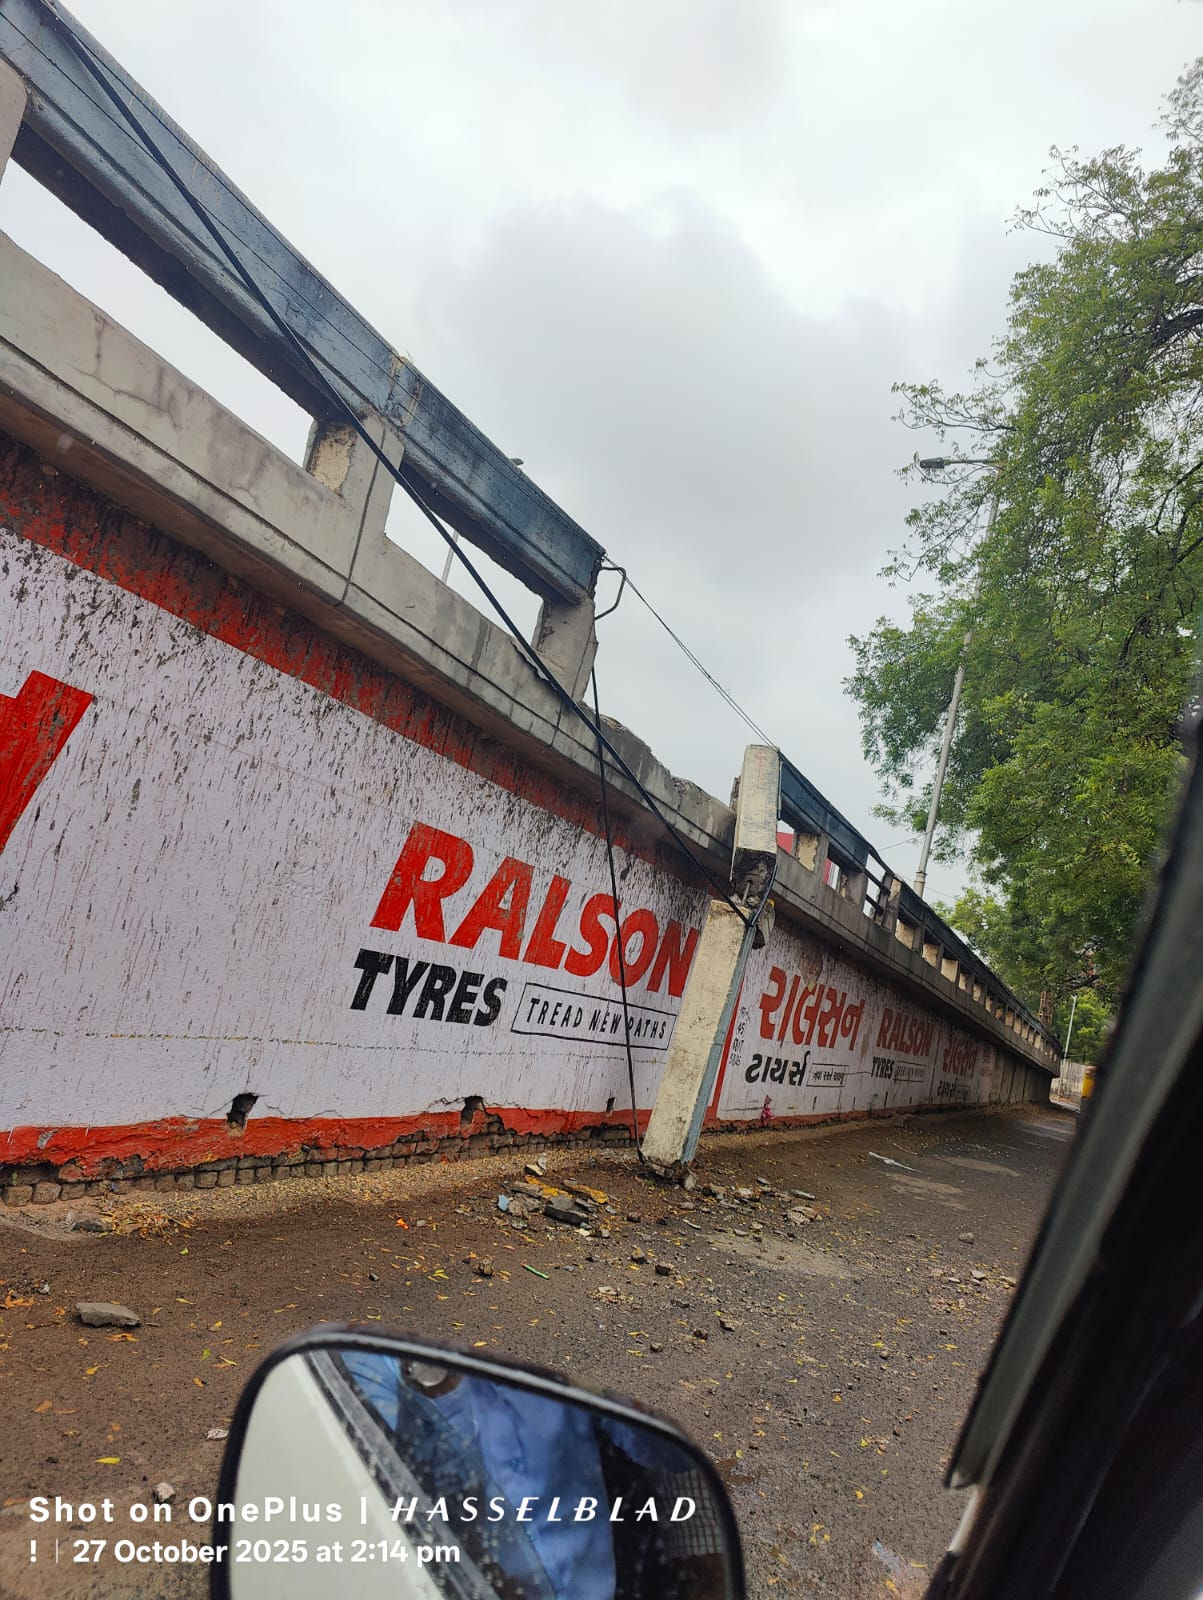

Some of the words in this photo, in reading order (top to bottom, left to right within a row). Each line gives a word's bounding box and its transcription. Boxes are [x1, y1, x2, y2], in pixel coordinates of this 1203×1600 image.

[370, 820, 699, 998] RALSON
[350, 948, 508, 1027] TYRES
[526, 998, 583, 1029] TREAD
[589, 1008, 622, 1035] NEW
[627, 1015, 667, 1040] PATHS
[759, 965, 866, 1051] રાલસન
[876, 1007, 934, 1056] RALSON
[745, 1050, 811, 1087] ટાયર્સ
